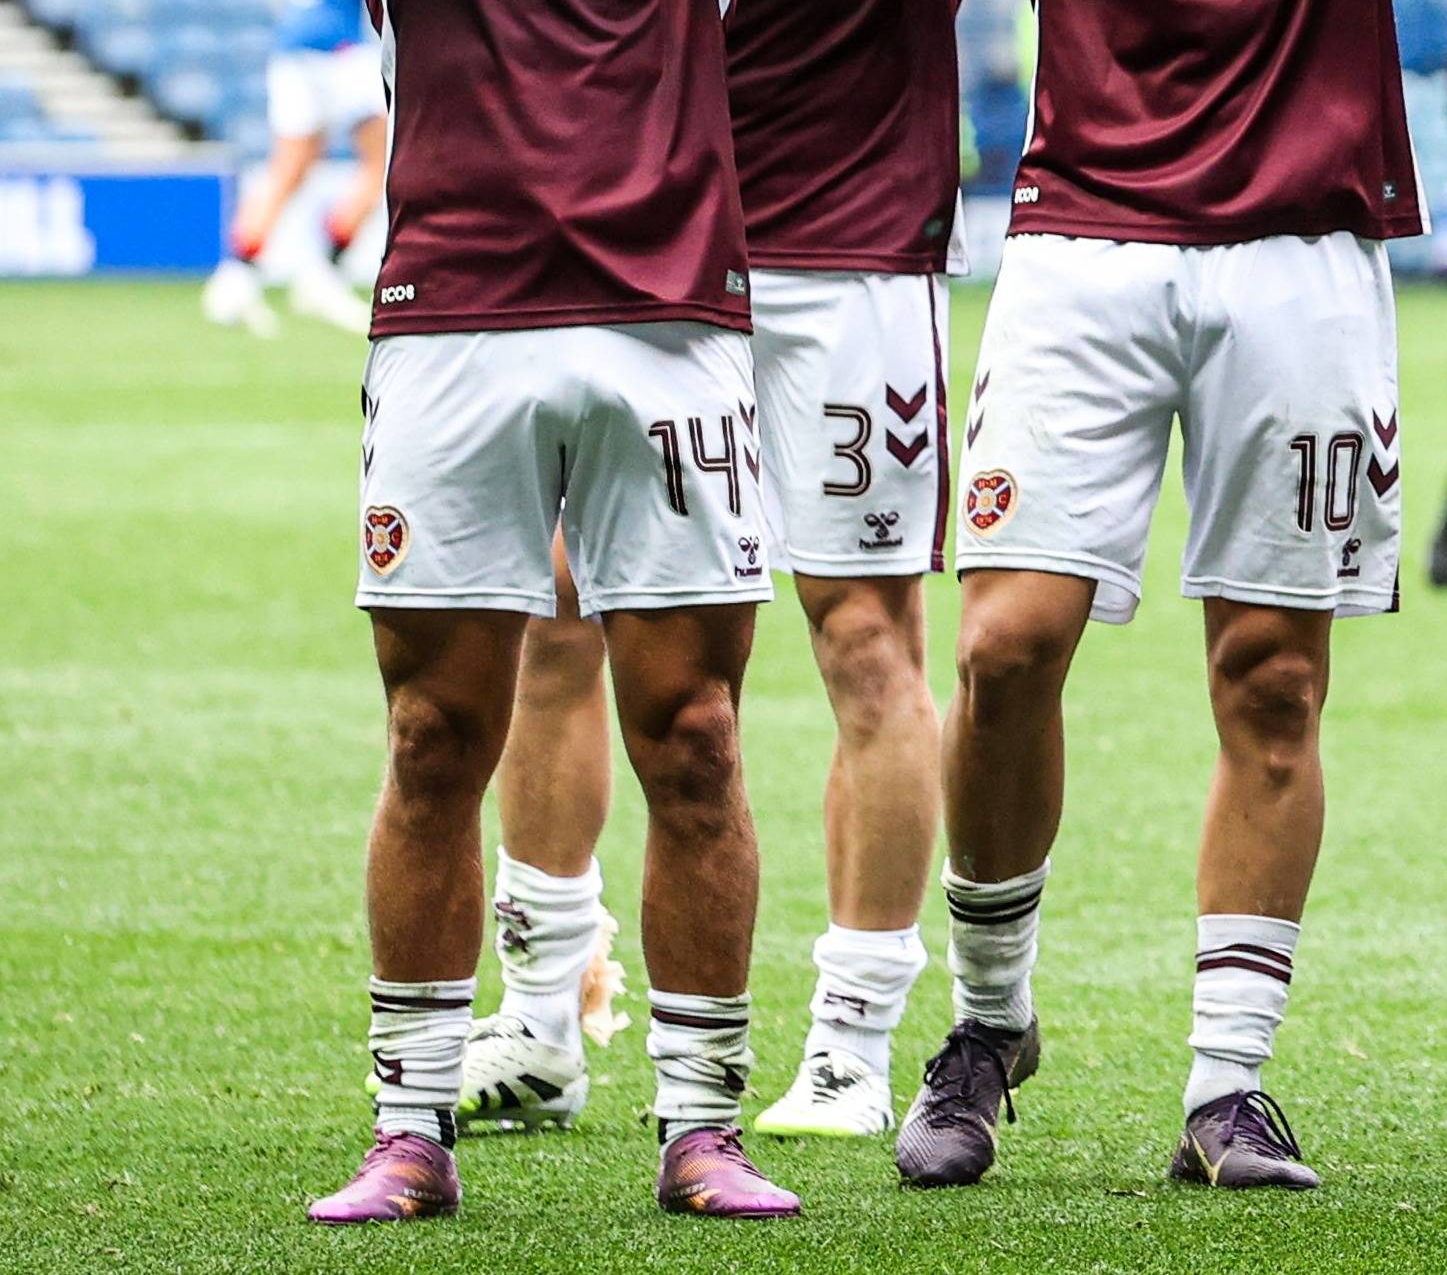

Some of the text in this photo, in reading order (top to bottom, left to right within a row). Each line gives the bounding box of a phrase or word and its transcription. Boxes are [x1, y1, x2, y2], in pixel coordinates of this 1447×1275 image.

[648, 414, 742, 517] 14
[822, 403, 872, 497] 3
[1290, 431, 1364, 533] 10
